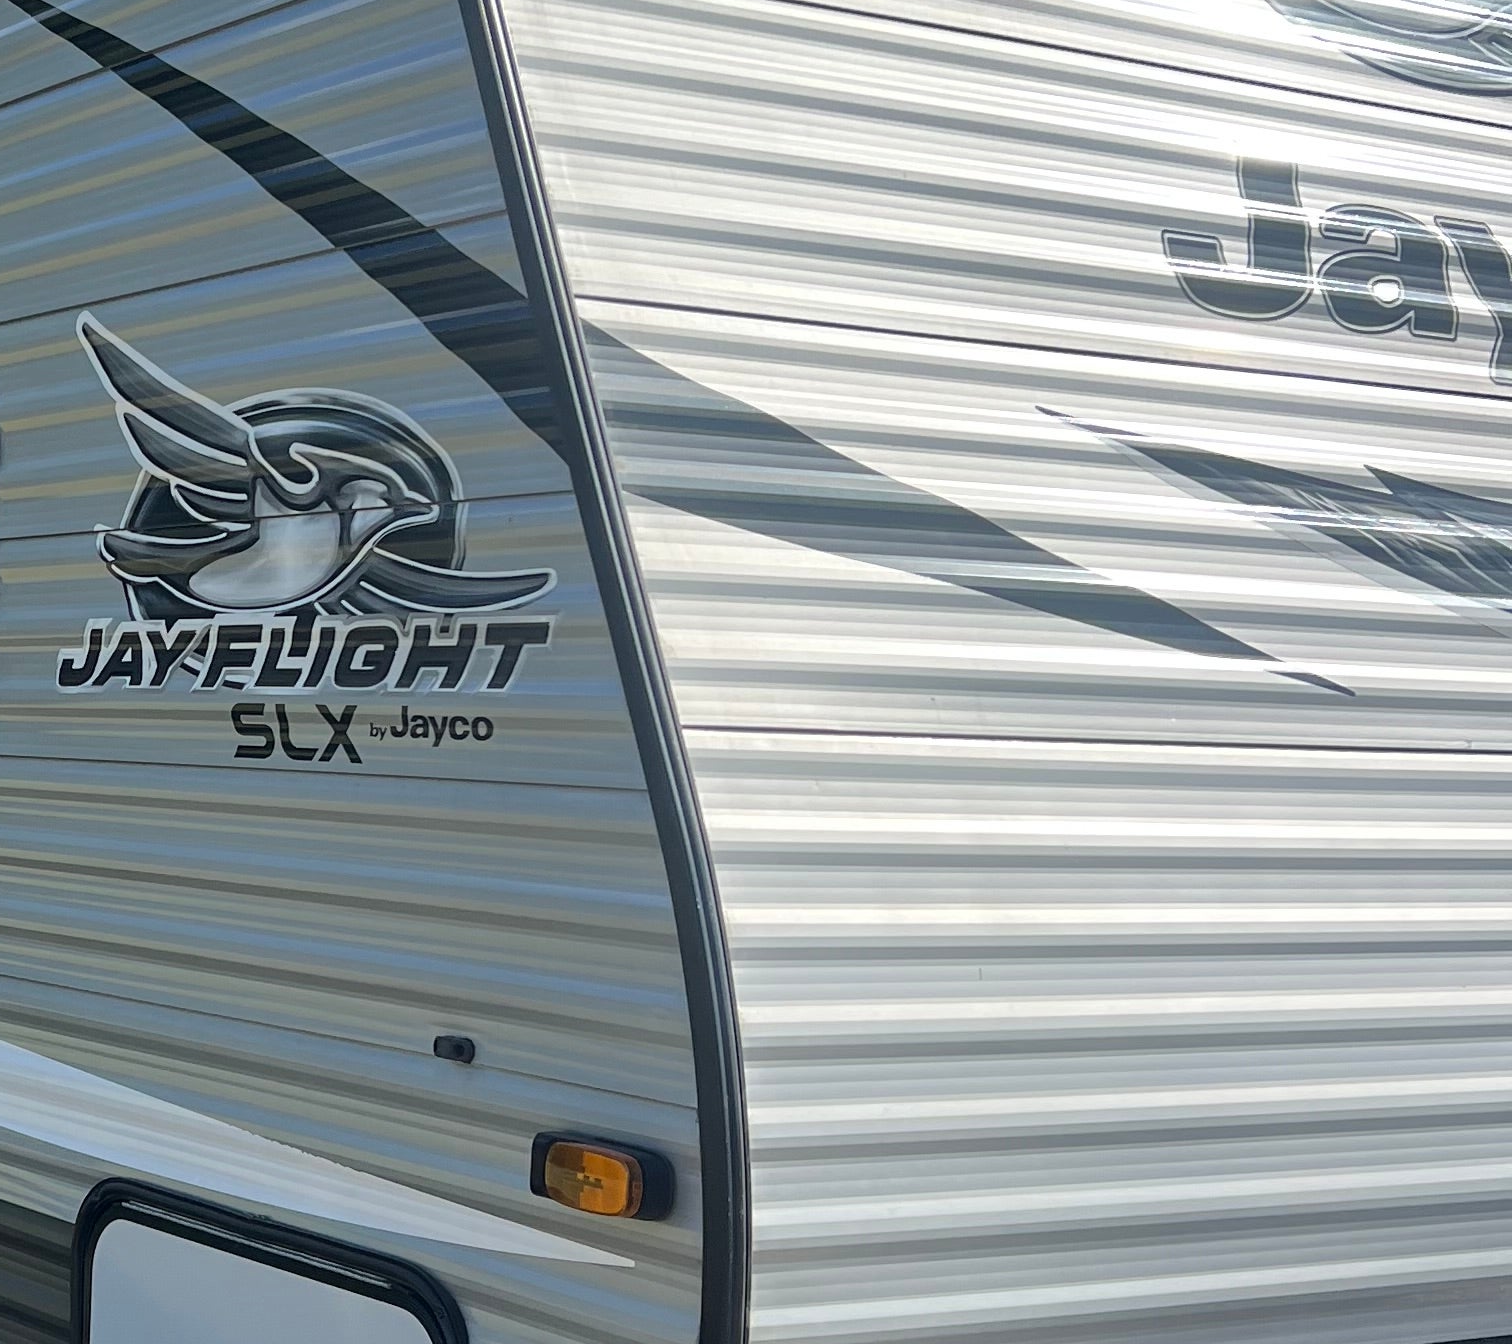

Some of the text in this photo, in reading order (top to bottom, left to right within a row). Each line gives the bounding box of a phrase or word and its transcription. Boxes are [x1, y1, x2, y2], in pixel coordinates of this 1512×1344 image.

[56, 620, 551, 691] JAY FLIGHT
[230, 702, 494, 765] SLX by Jayco
